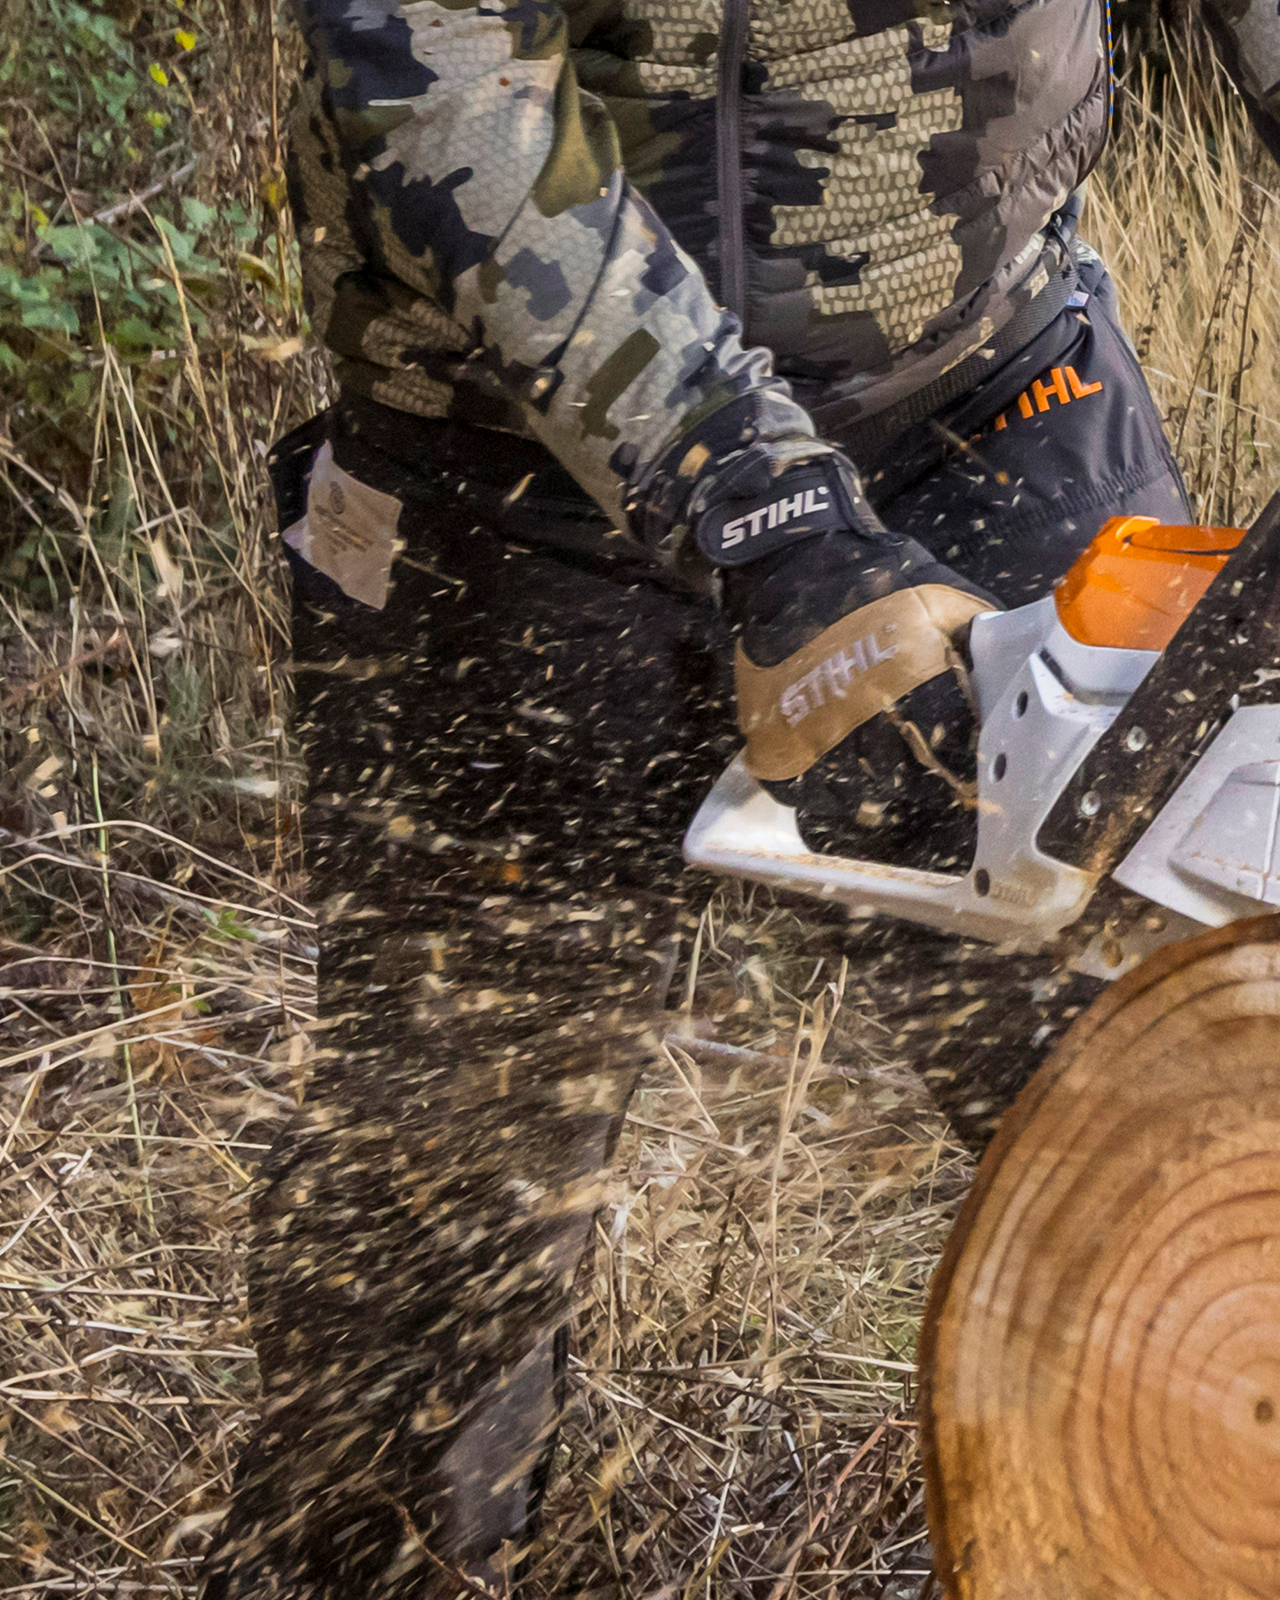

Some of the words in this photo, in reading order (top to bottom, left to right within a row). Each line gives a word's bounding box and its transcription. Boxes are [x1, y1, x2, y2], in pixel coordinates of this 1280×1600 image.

[970, 365, 1103, 440] IHL
[720, 488, 830, 549] STIHL
[779, 632, 900, 728] STIHL
